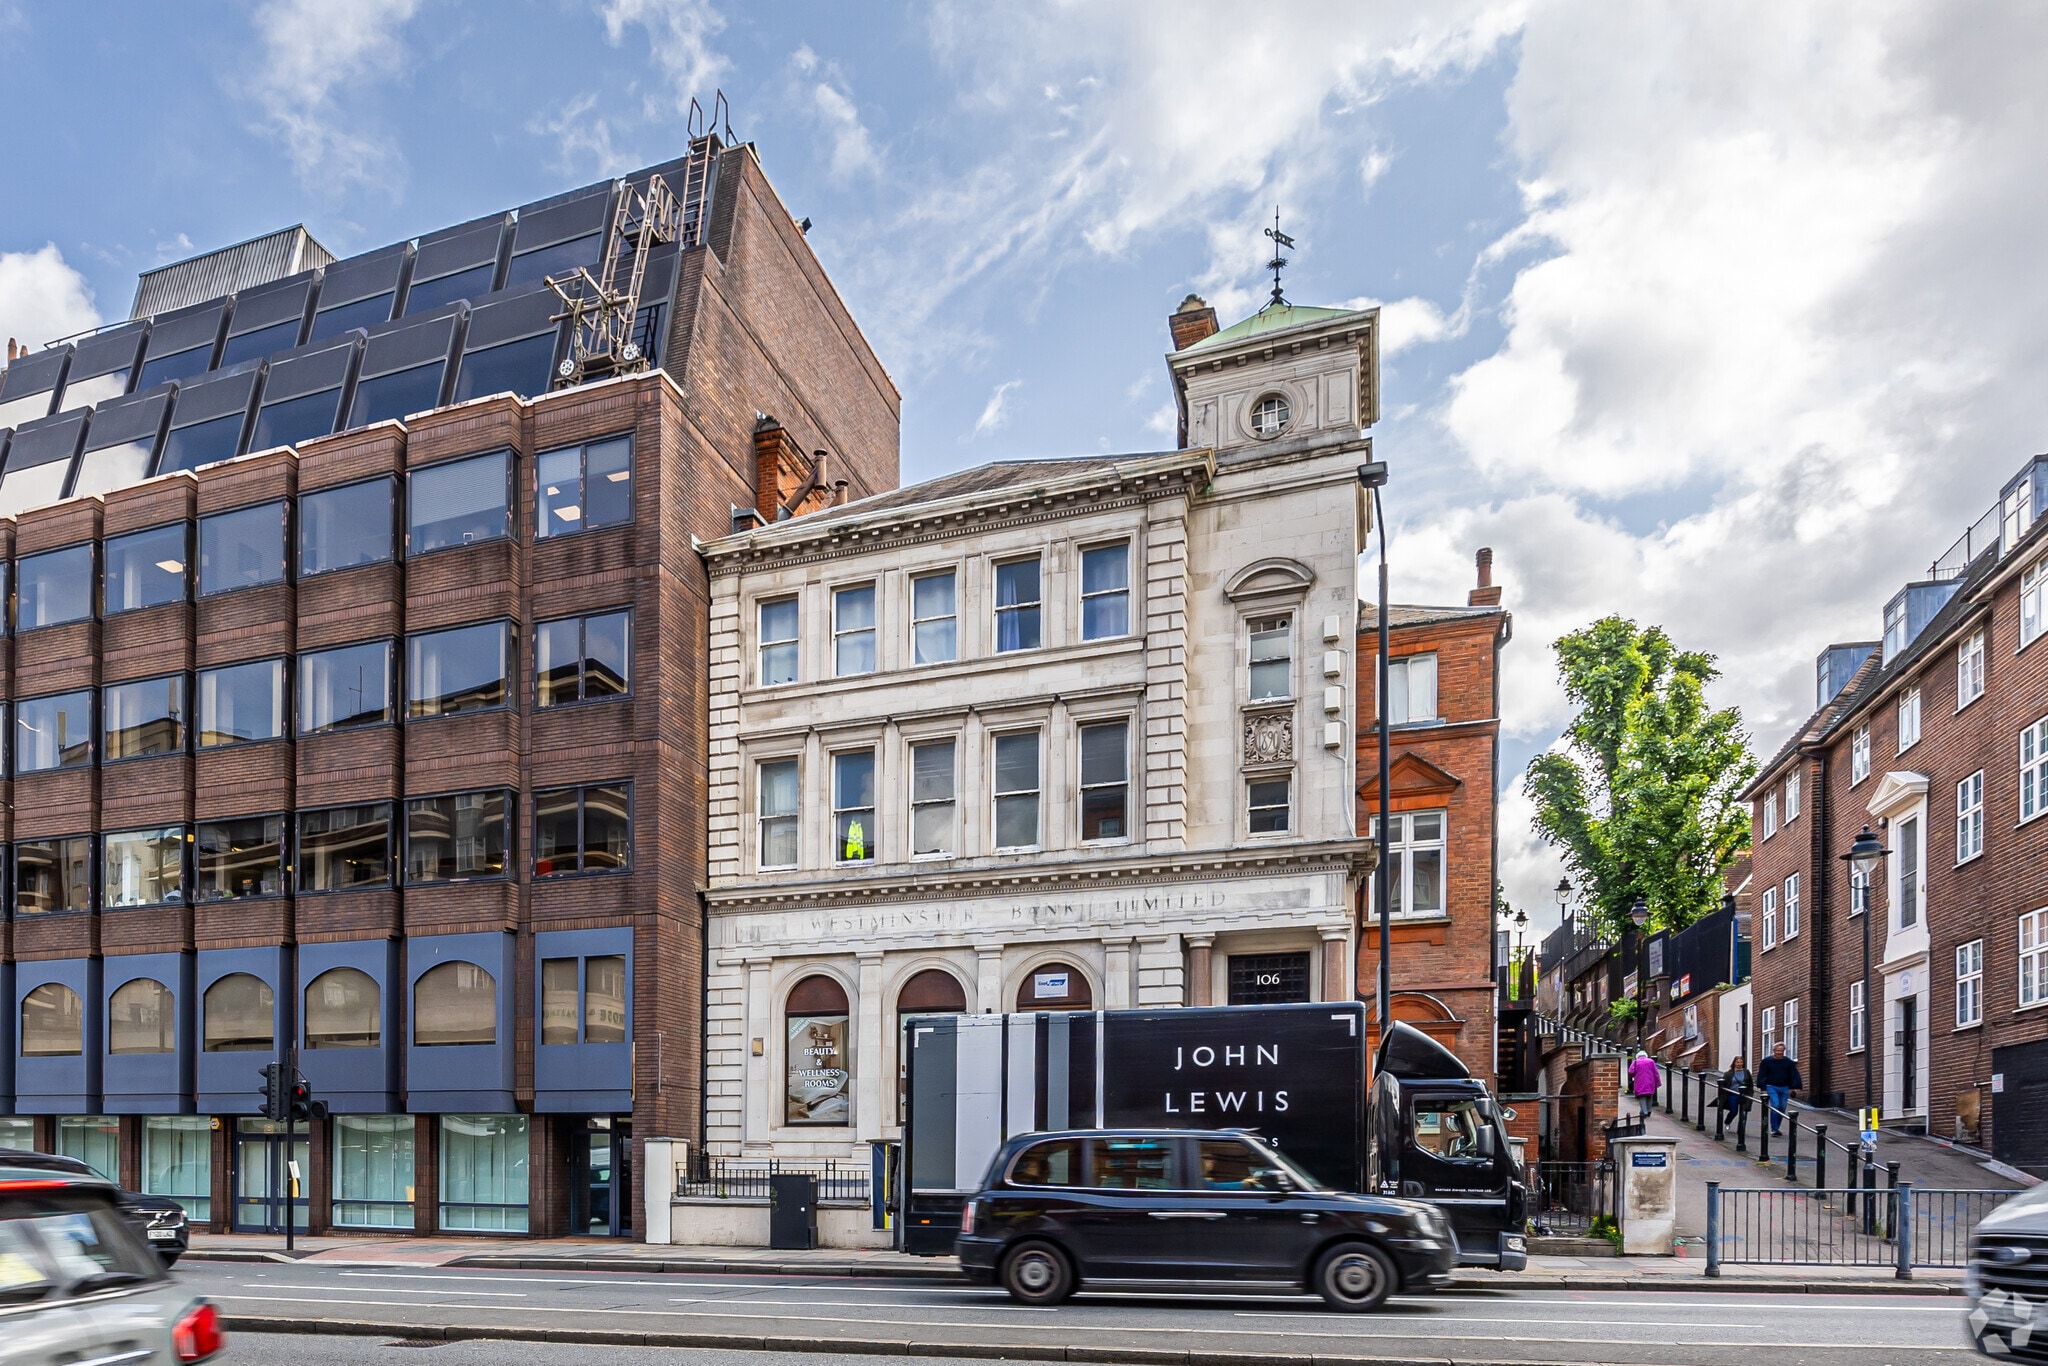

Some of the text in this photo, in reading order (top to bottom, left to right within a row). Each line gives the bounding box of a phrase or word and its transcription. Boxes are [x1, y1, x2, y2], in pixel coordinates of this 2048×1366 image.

[1011, 902, 1073, 920] BANK
[1256, 972, 1280, 986] 106
[804, 1047, 835, 1056] BEAUTY
[816, 1058, 822, 1066] &
[1174, 1044, 1279, 1071] JOHN
[798, 1068, 840, 1077] WELLNESS
[804, 1079, 834, 1088] ROOMS
[1165, 1090, 1289, 1113] LEWIS
